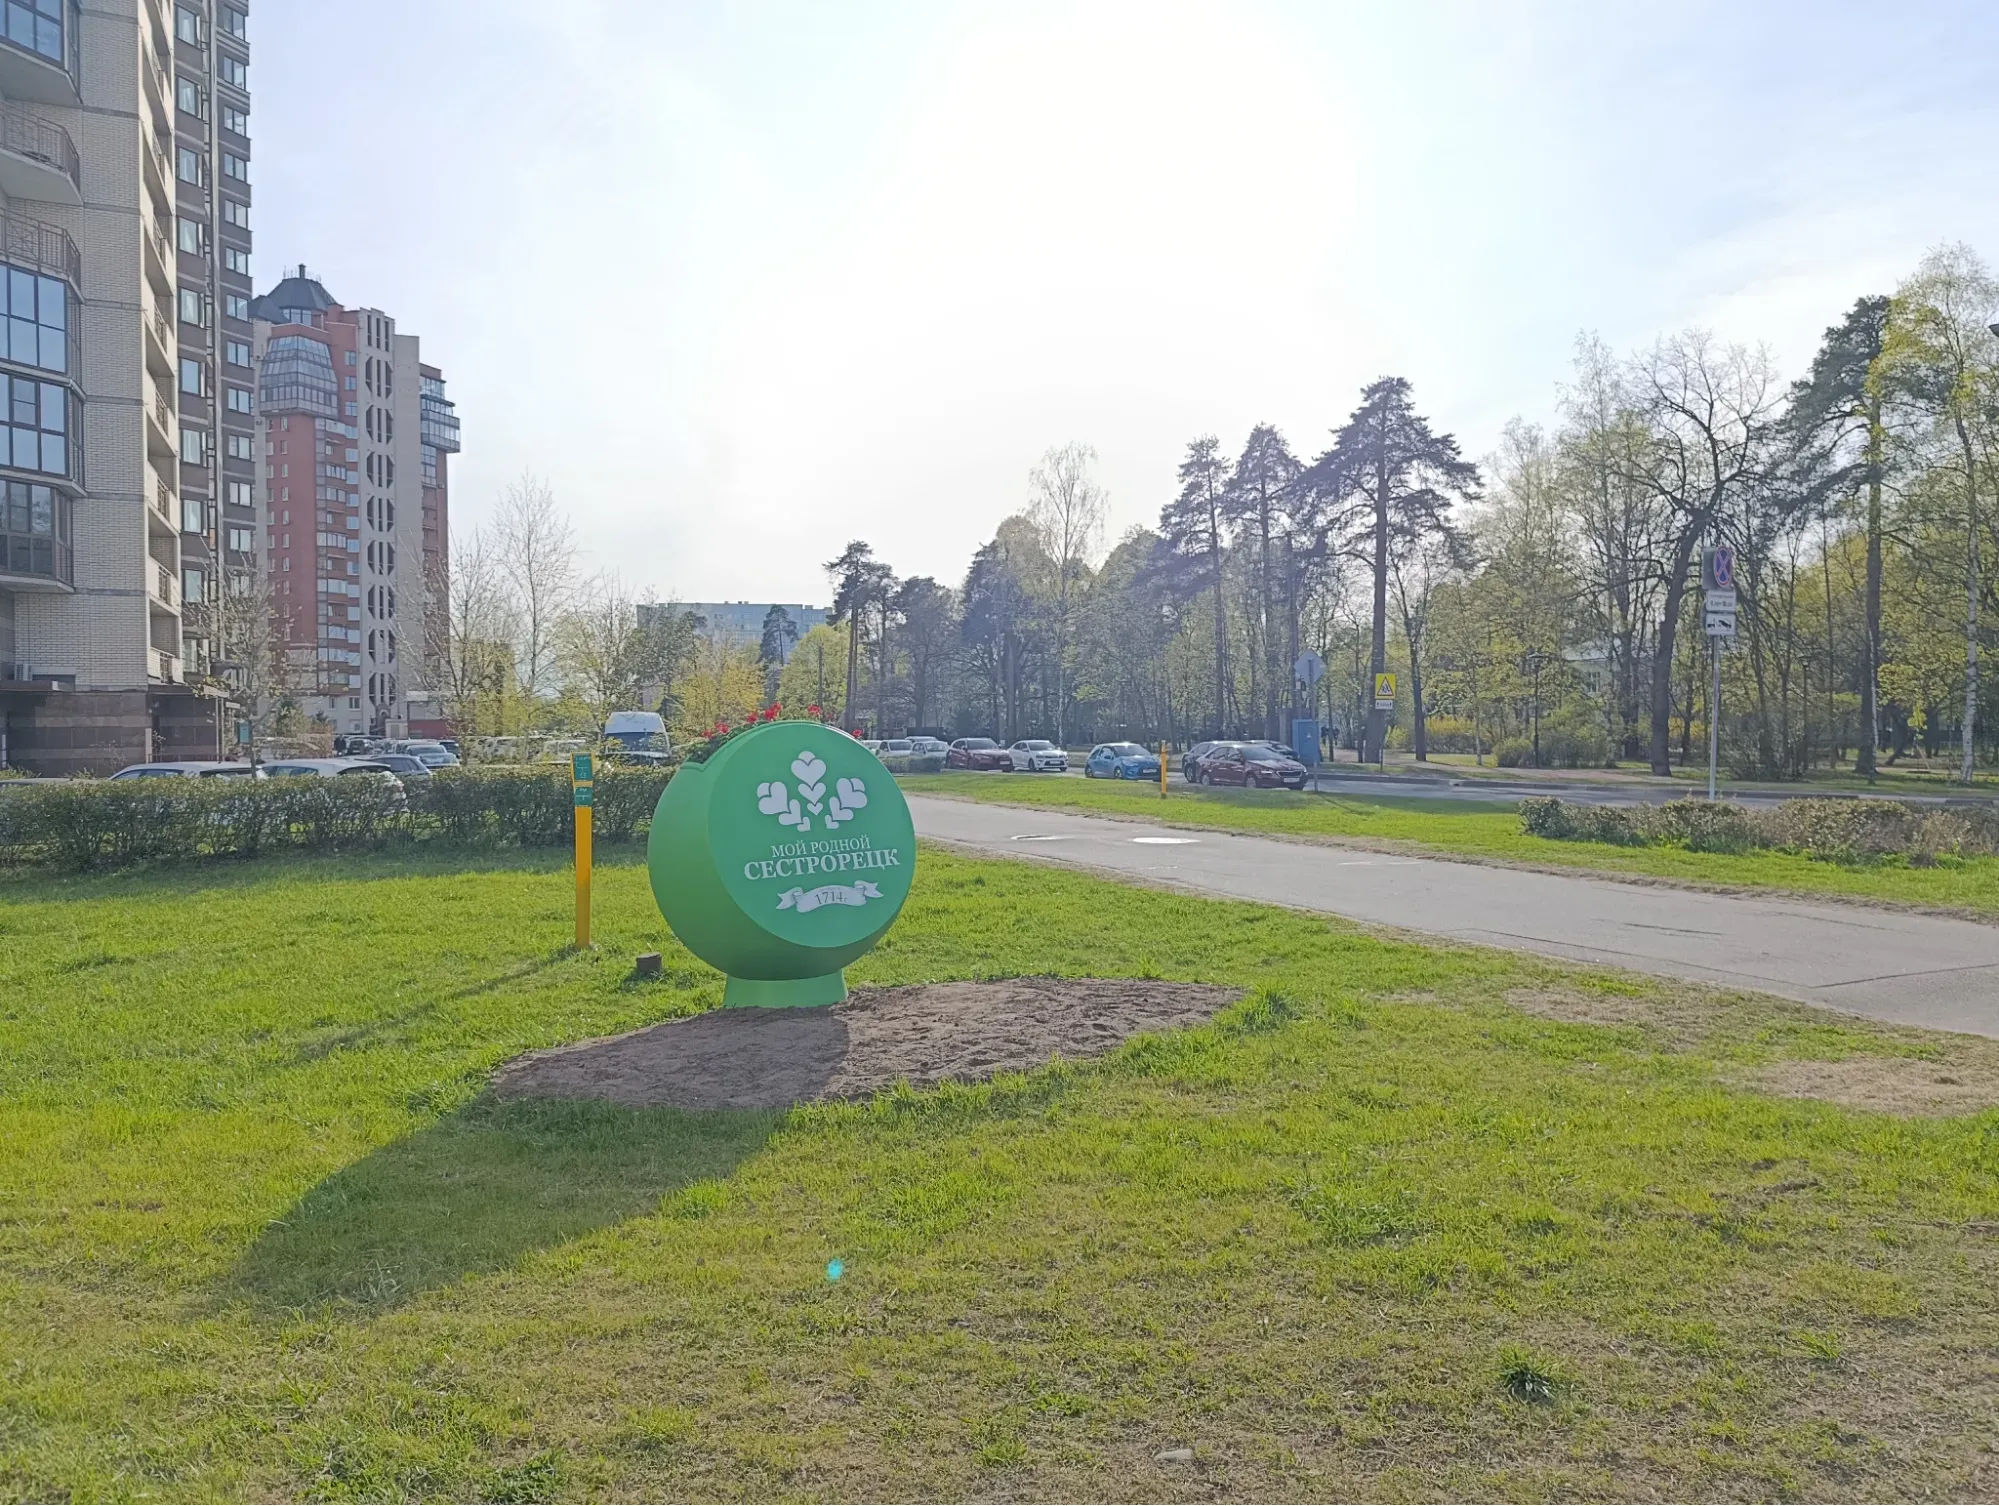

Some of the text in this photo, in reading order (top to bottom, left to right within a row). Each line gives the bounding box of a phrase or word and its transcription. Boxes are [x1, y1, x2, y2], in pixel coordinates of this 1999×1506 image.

[771, 834, 871, 857] МОЙ РОДНОЙ
[744, 849, 900, 880] СЕСТРОРЕЦК
